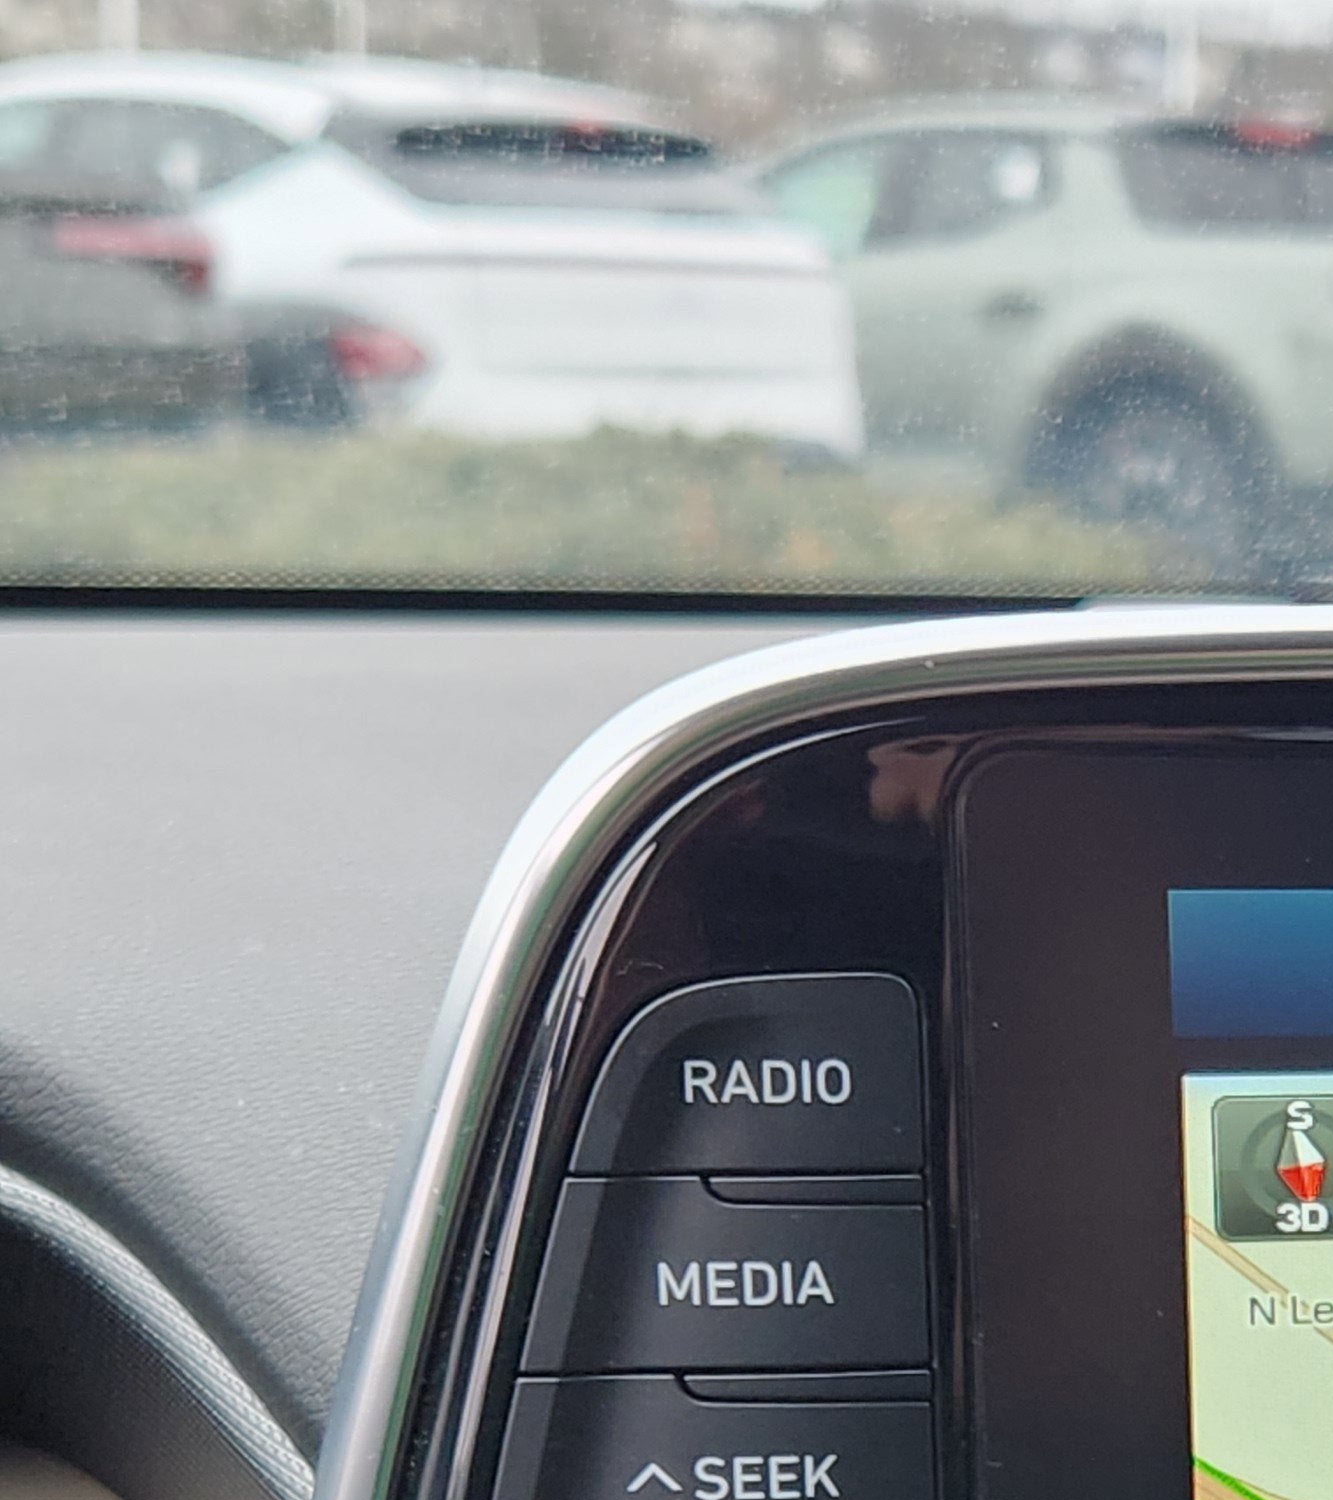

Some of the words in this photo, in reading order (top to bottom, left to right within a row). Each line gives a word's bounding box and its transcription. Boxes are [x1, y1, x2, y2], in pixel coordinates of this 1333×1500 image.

[683, 1058, 852, 1105] RADIO
[1285, 1099, 1316, 1131] S
[1274, 1201, 1331, 1234] 3D
[656, 1260, 835, 1307] MEDIA
[1248, 1296, 1277, 1327] N
